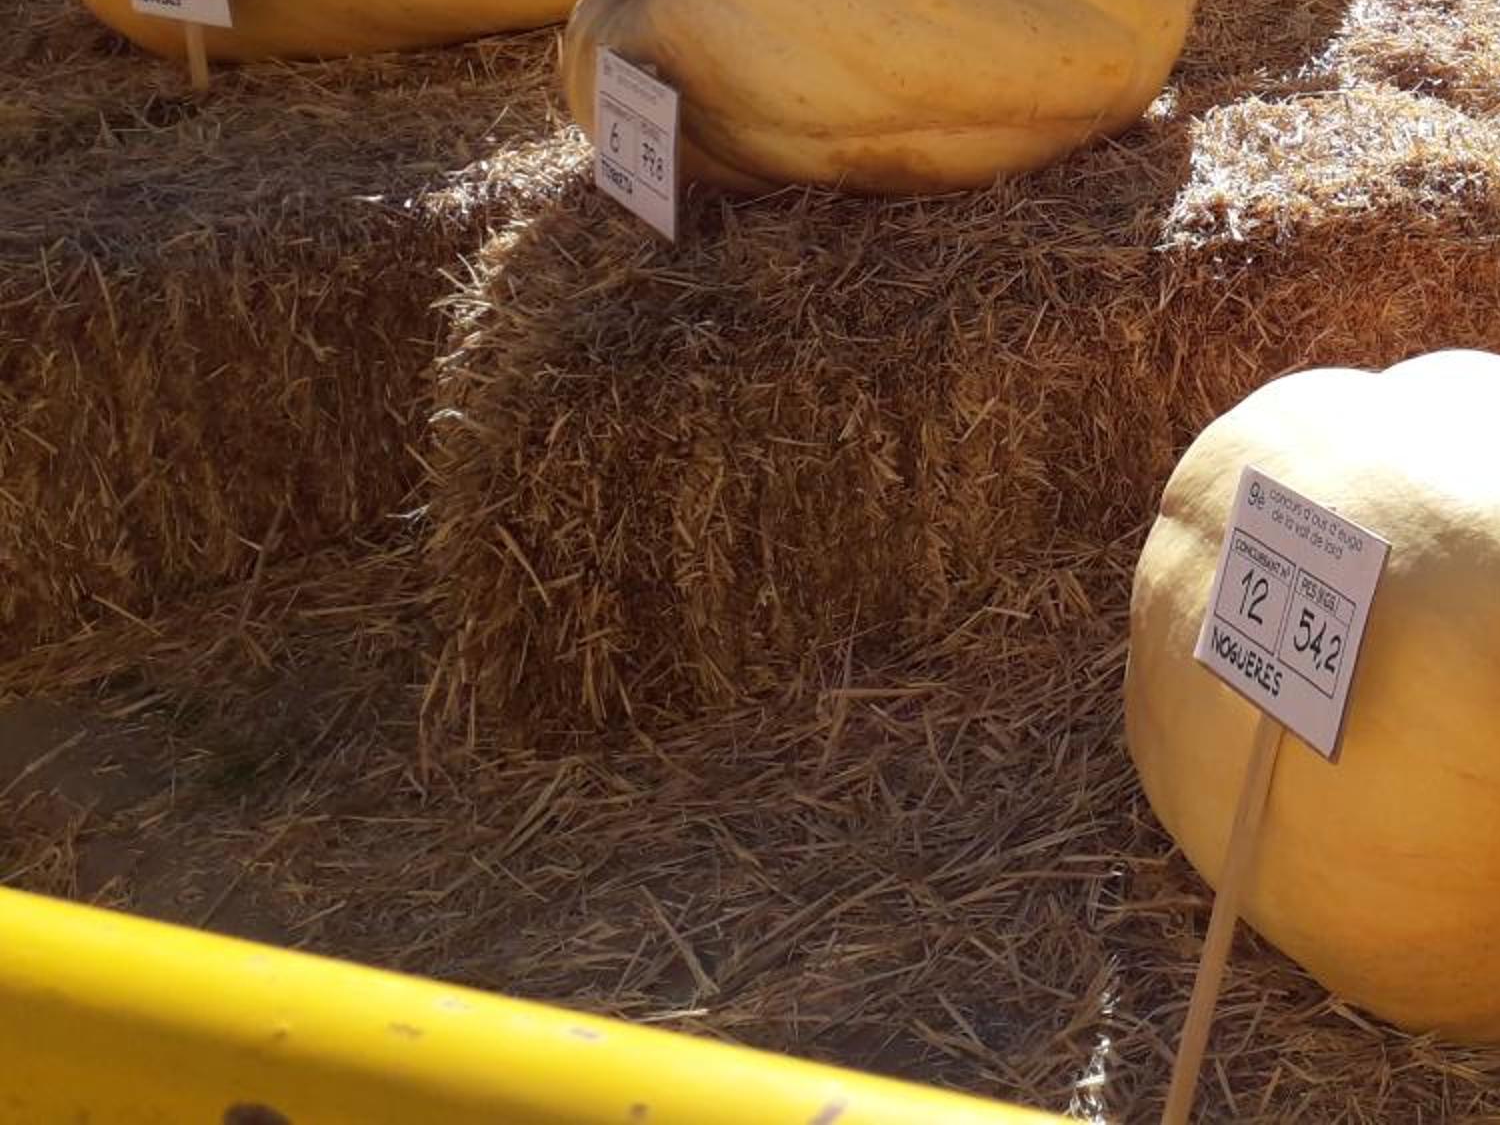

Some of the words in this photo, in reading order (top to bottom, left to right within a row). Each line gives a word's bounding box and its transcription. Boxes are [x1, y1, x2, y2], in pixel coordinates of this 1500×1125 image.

[610, 122, 619, 153] 6
[1240, 568, 1269, 625] 12
[1211, 626, 1284, 698] NOGUERES
[1293, 608, 1342, 673] 54,2
